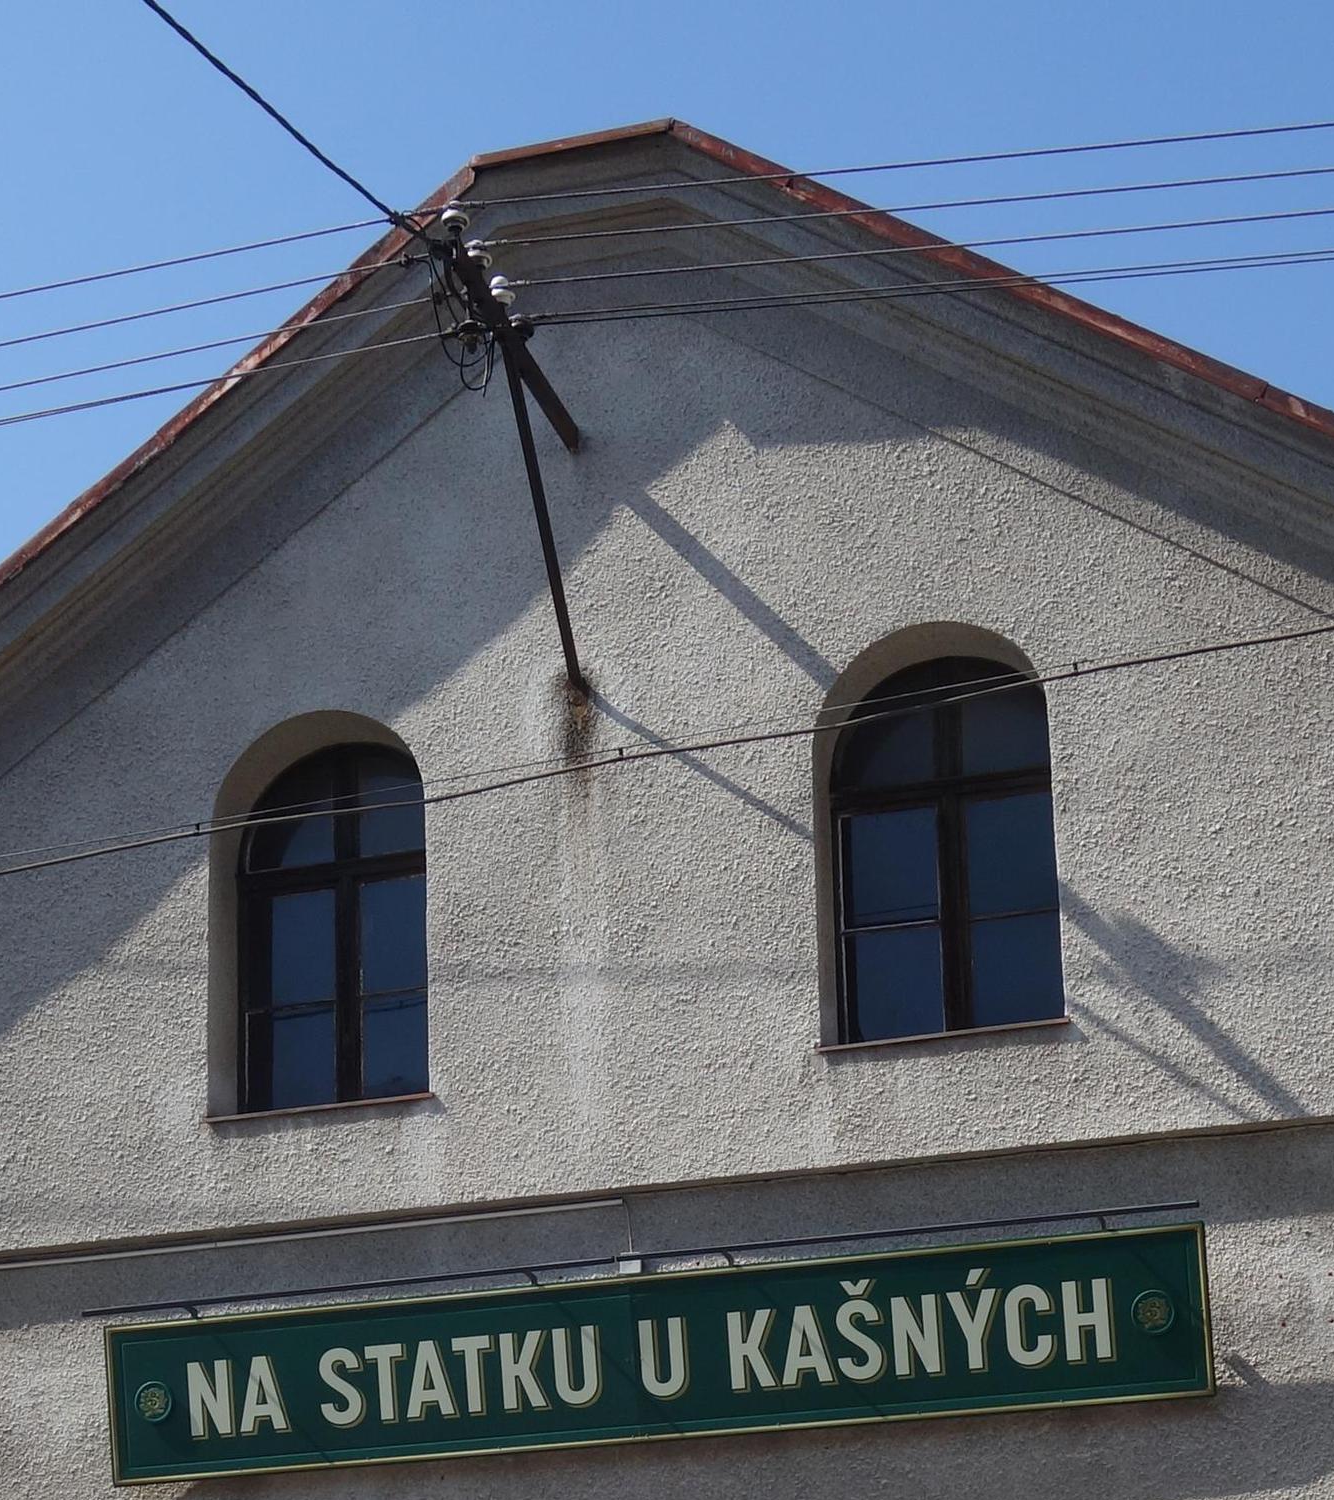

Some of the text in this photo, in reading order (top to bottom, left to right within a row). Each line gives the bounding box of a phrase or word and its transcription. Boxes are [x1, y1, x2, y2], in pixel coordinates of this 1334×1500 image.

[186, 1270, 1115, 1439] NA STATKU U KAŠNÝCH
